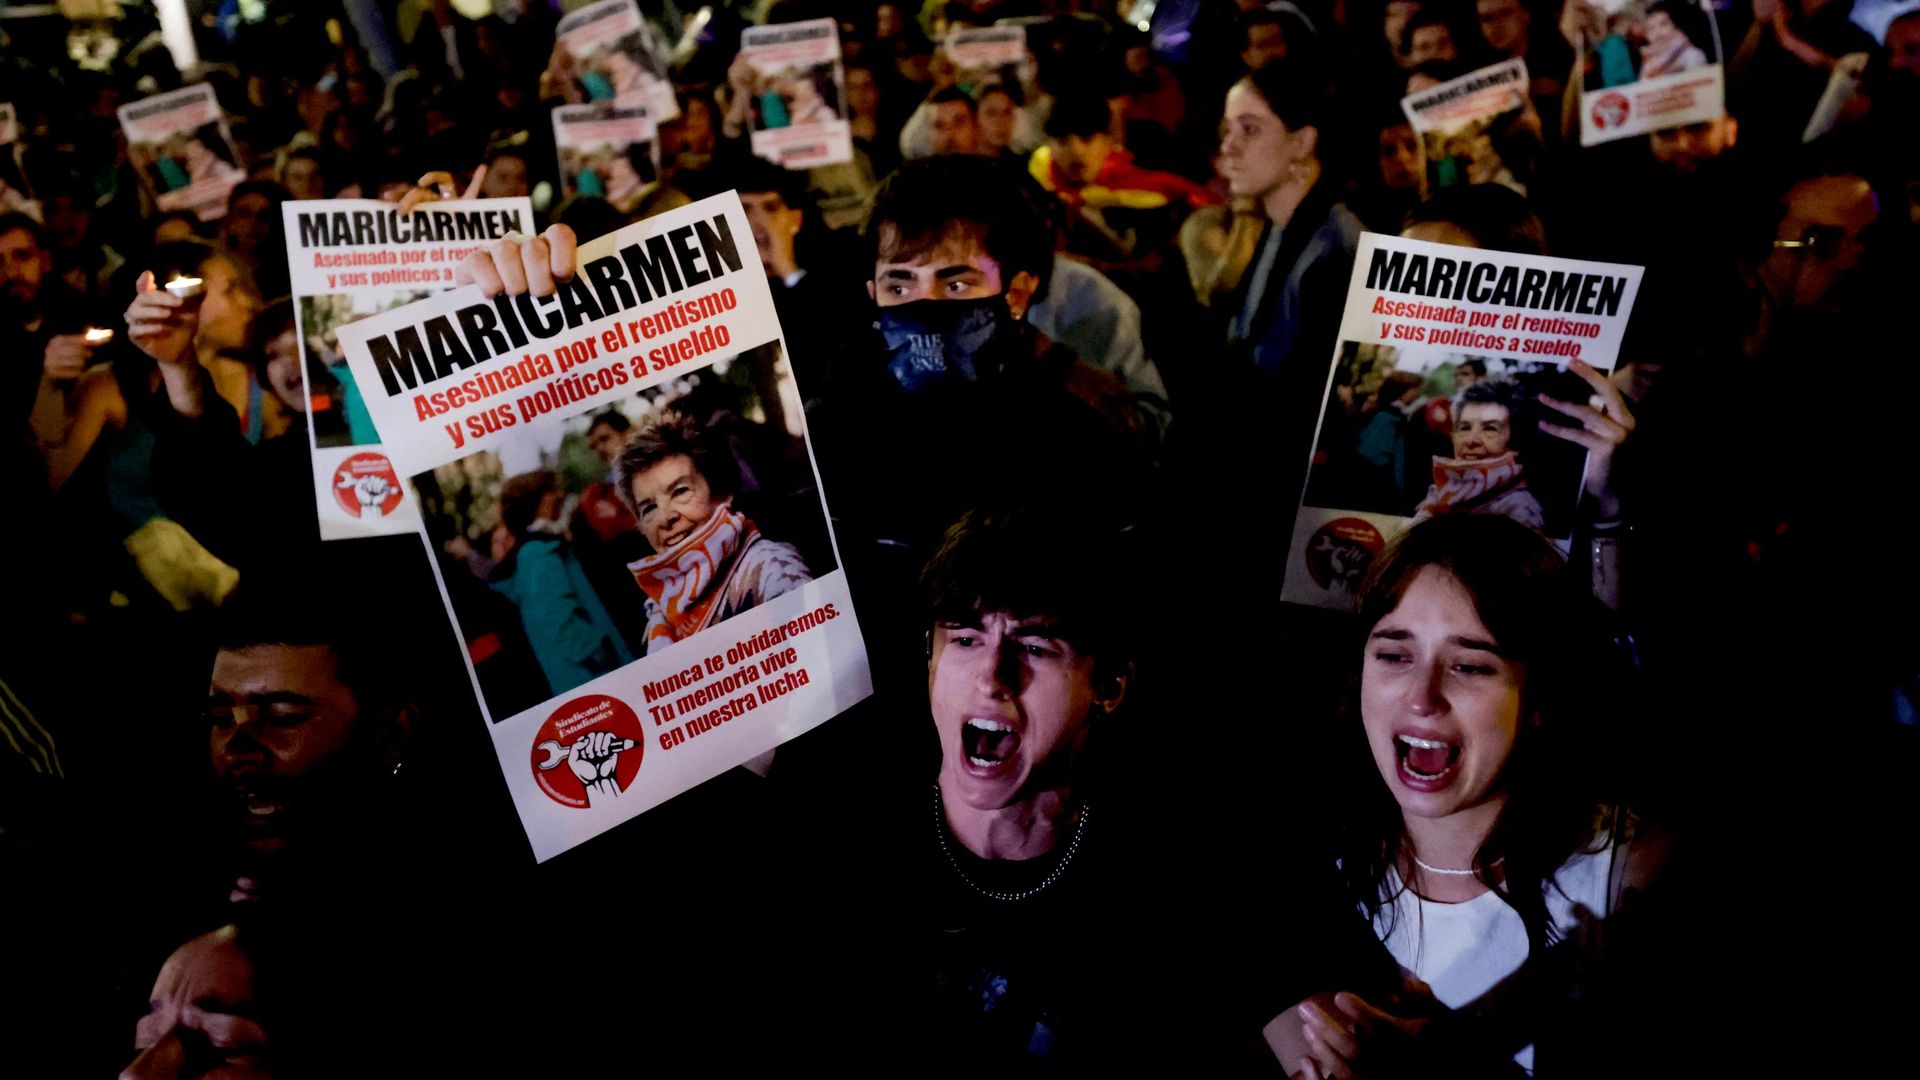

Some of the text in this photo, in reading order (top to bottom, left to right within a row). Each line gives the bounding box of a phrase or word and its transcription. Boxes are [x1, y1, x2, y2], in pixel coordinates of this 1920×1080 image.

[298, 209, 523, 248] MARICARMEN
[314, 251, 397, 268] Asesinada
[401, 251, 427, 266] por
[430, 248, 446, 262] el
[327, 274, 337, 288] y
[340, 273, 367, 286] sus
[443, 268, 453, 281] a
[366, 213, 743, 397] MARICARMEN
[1366, 248, 1627, 316] MARICARMEN
[413, 287, 738, 421] Asesinada por el rentismo
[1372, 296, 1602, 339] Asesinada por el rentismo
[1380, 321, 1392, 340] y
[1394, 324, 1425, 342] sus
[1508, 338, 1520, 352] a
[1523, 339, 1582, 358] sueldo
[445, 324, 732, 449] y sus políticos a sueldo
[642, 665, 704, 703] Nunca
[704, 655, 725, 675] te
[726, 603, 840, 665] olvidaremos.
[649, 647, 798, 726] Tu memoria vive
[659, 668, 811, 751] en nuestra lucha
